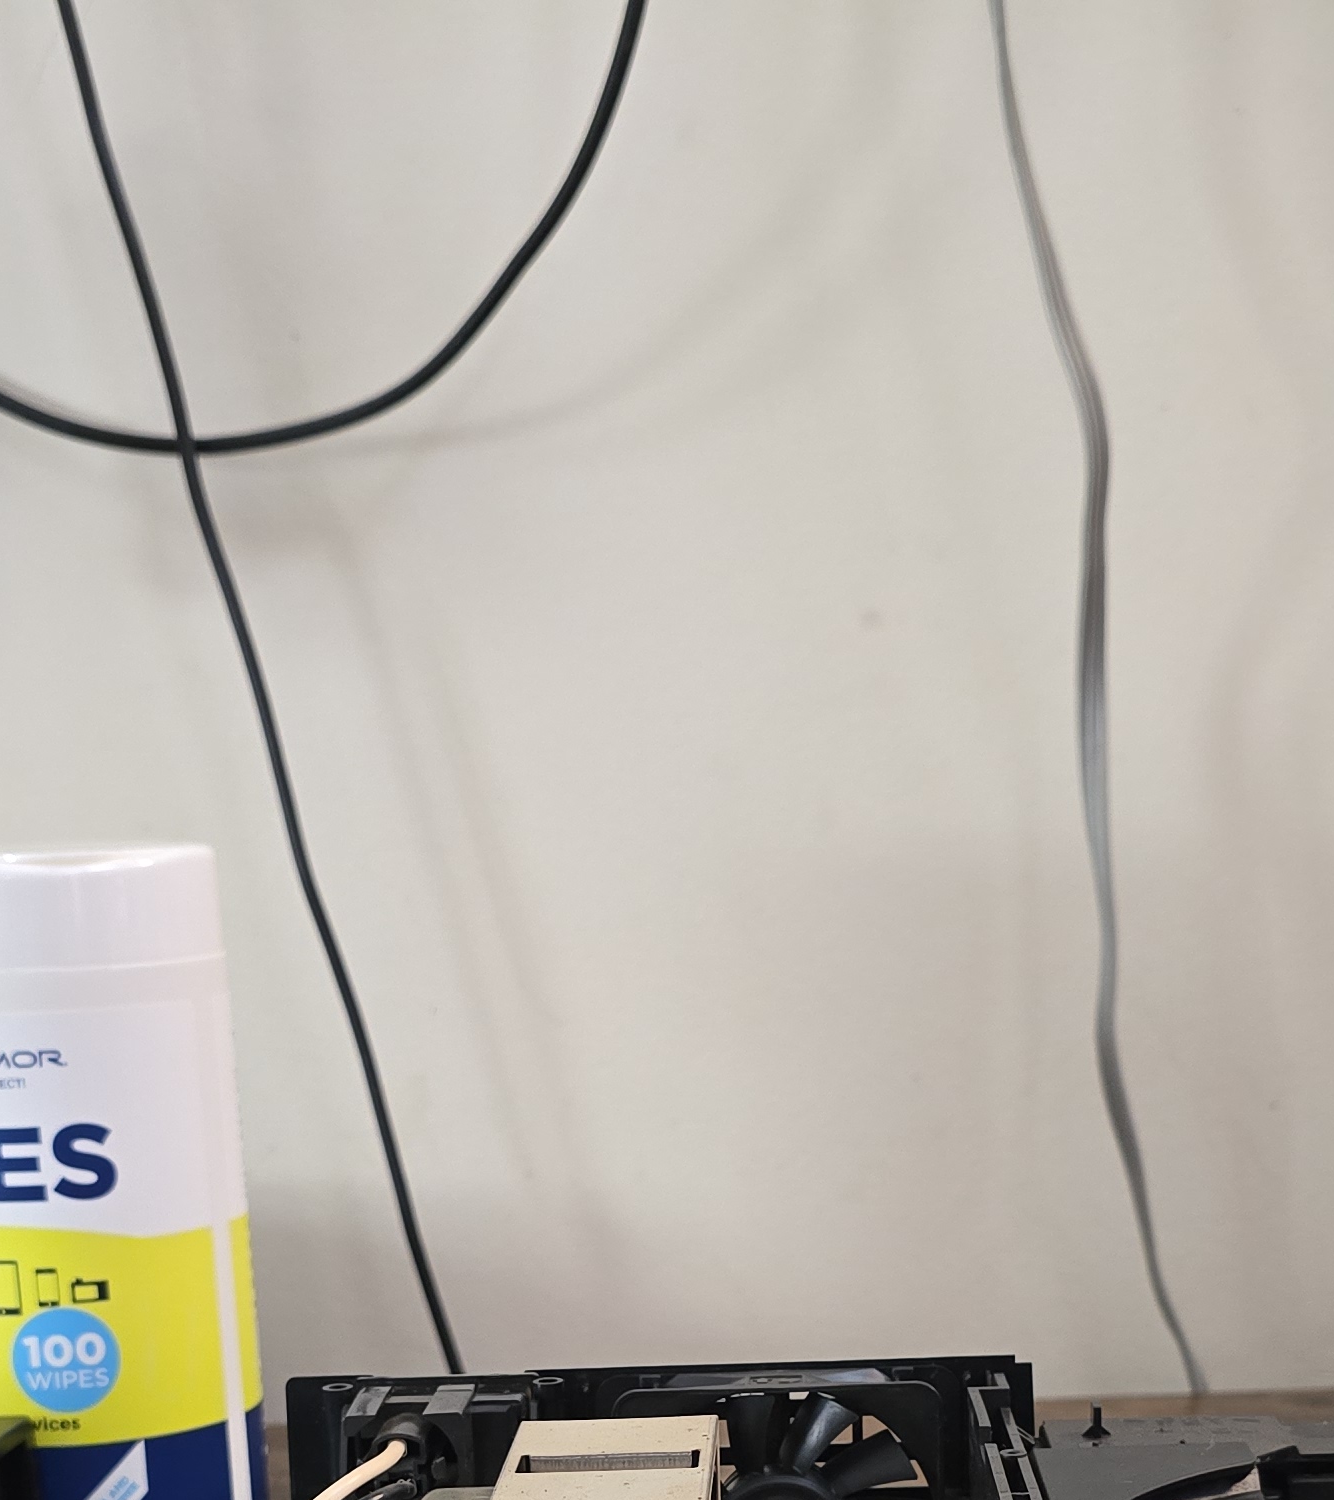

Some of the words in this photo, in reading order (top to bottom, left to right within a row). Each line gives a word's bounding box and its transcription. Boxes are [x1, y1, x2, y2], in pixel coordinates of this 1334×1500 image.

[21, 1331, 108, 1369] 100
[25, 1367, 110, 1392] WIPES
[33, 1416, 82, 1433] vices
